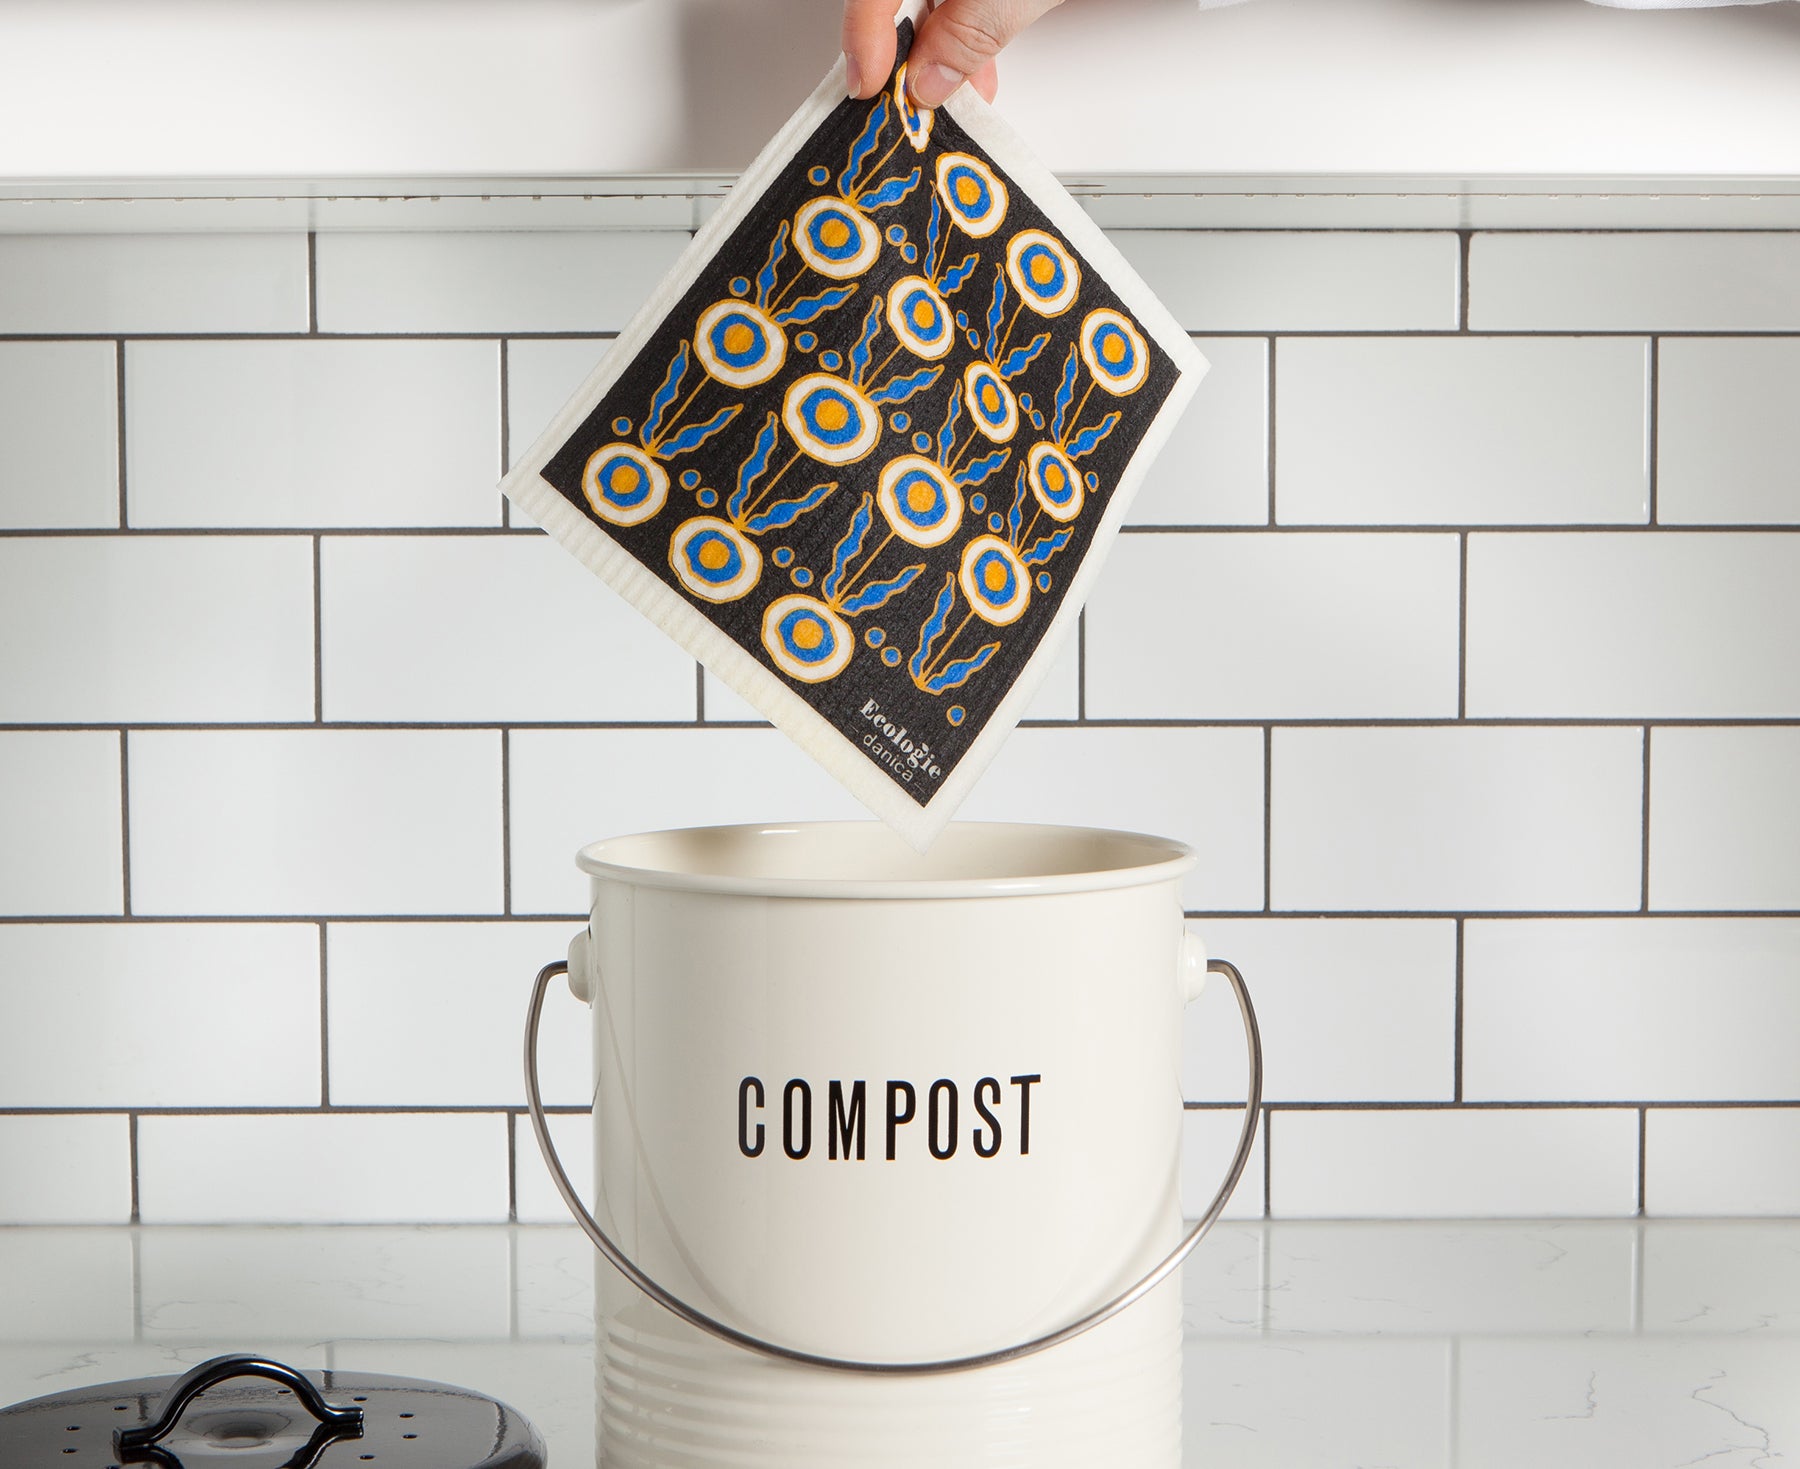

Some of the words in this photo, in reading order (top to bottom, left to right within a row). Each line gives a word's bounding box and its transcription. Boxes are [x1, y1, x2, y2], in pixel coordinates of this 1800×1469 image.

[860, 697, 941, 779] Ecologie
[863, 734, 914, 782] danica
[738, 1074, 1042, 1161] COMPOST
